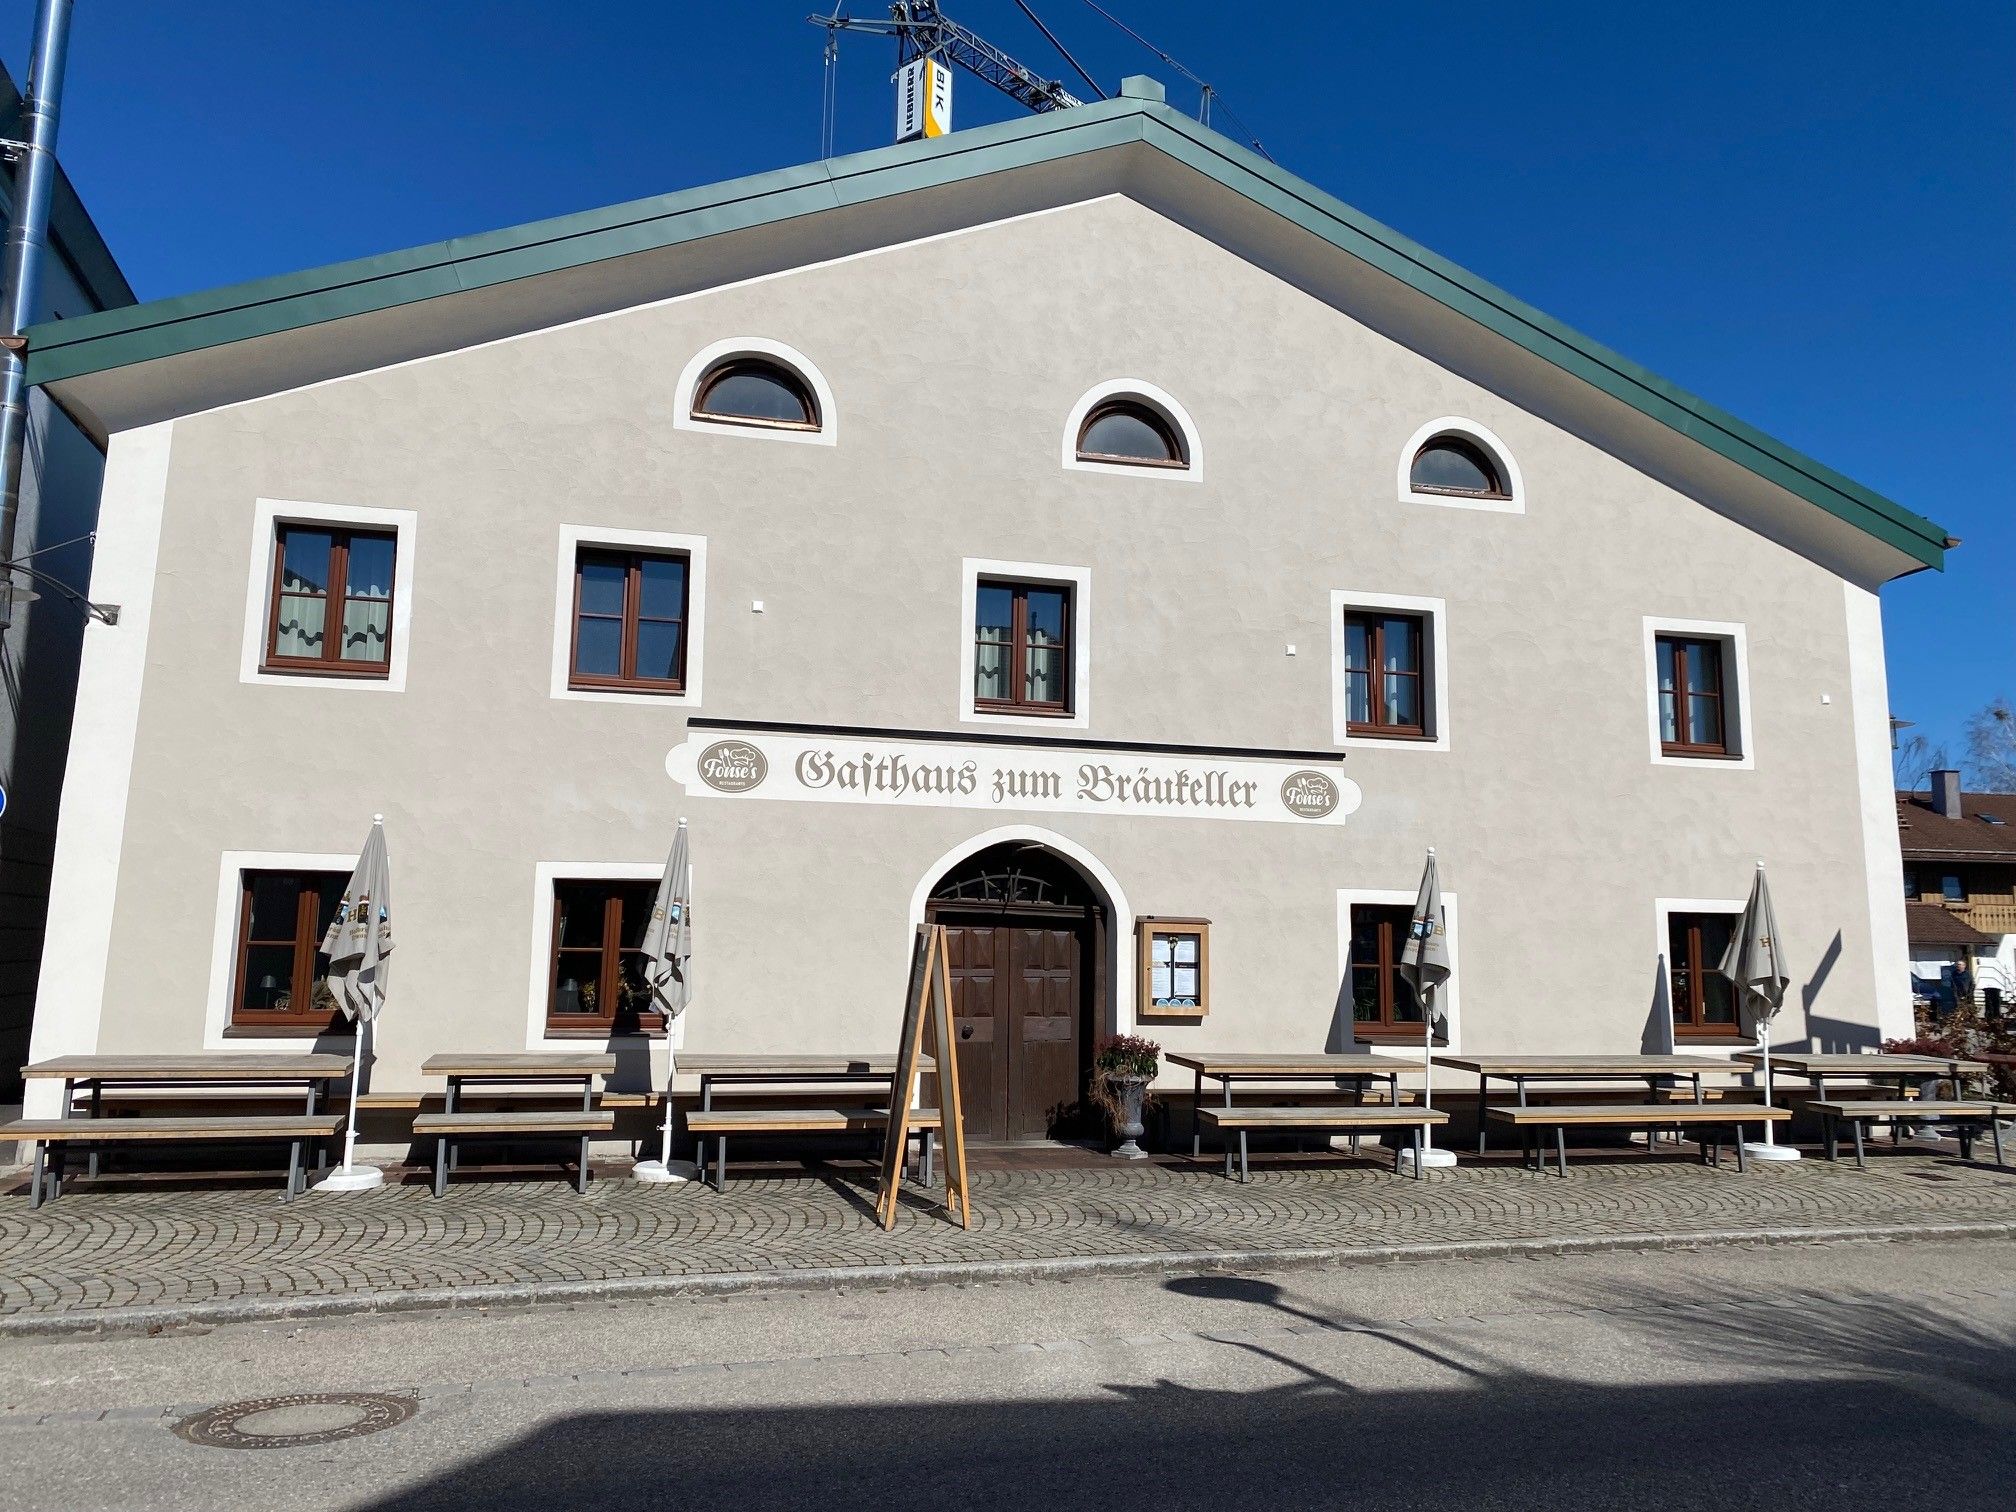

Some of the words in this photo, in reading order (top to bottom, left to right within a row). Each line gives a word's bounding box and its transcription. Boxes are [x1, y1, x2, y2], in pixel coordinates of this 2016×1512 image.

[906, 66, 914, 132] LIEBHERR
[992, 768, 1062, 803] zum
[1076, 764, 1258, 809] Bräukeller
